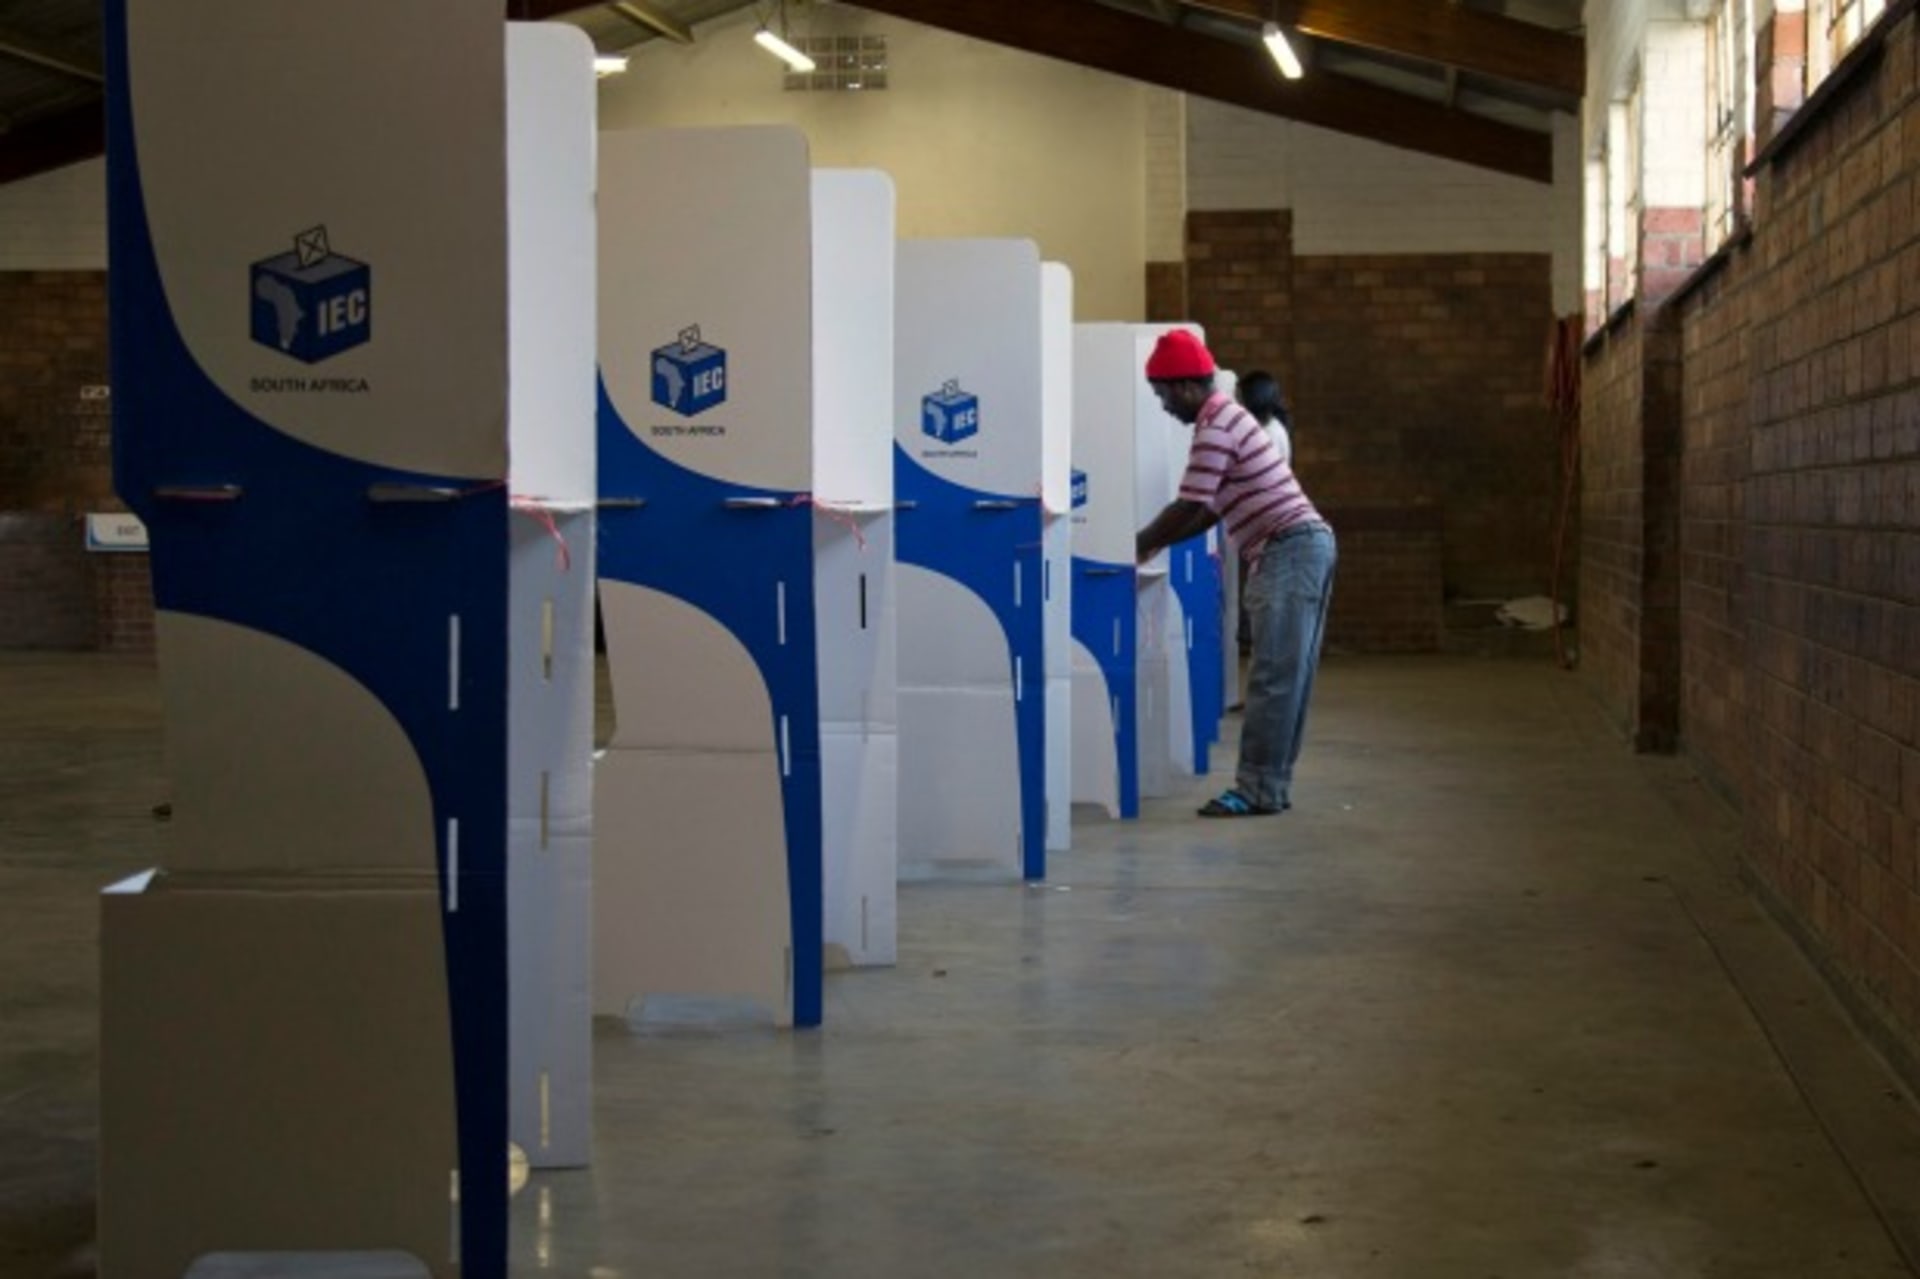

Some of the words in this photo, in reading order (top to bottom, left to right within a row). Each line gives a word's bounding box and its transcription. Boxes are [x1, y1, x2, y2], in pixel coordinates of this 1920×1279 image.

[317, 288, 366, 336] IEC
[250, 379, 306, 392] SOUTH
[310, 378, 369, 392] AFRICA
[693, 366, 723, 398] IEC
[953, 407, 976, 430] IEC
